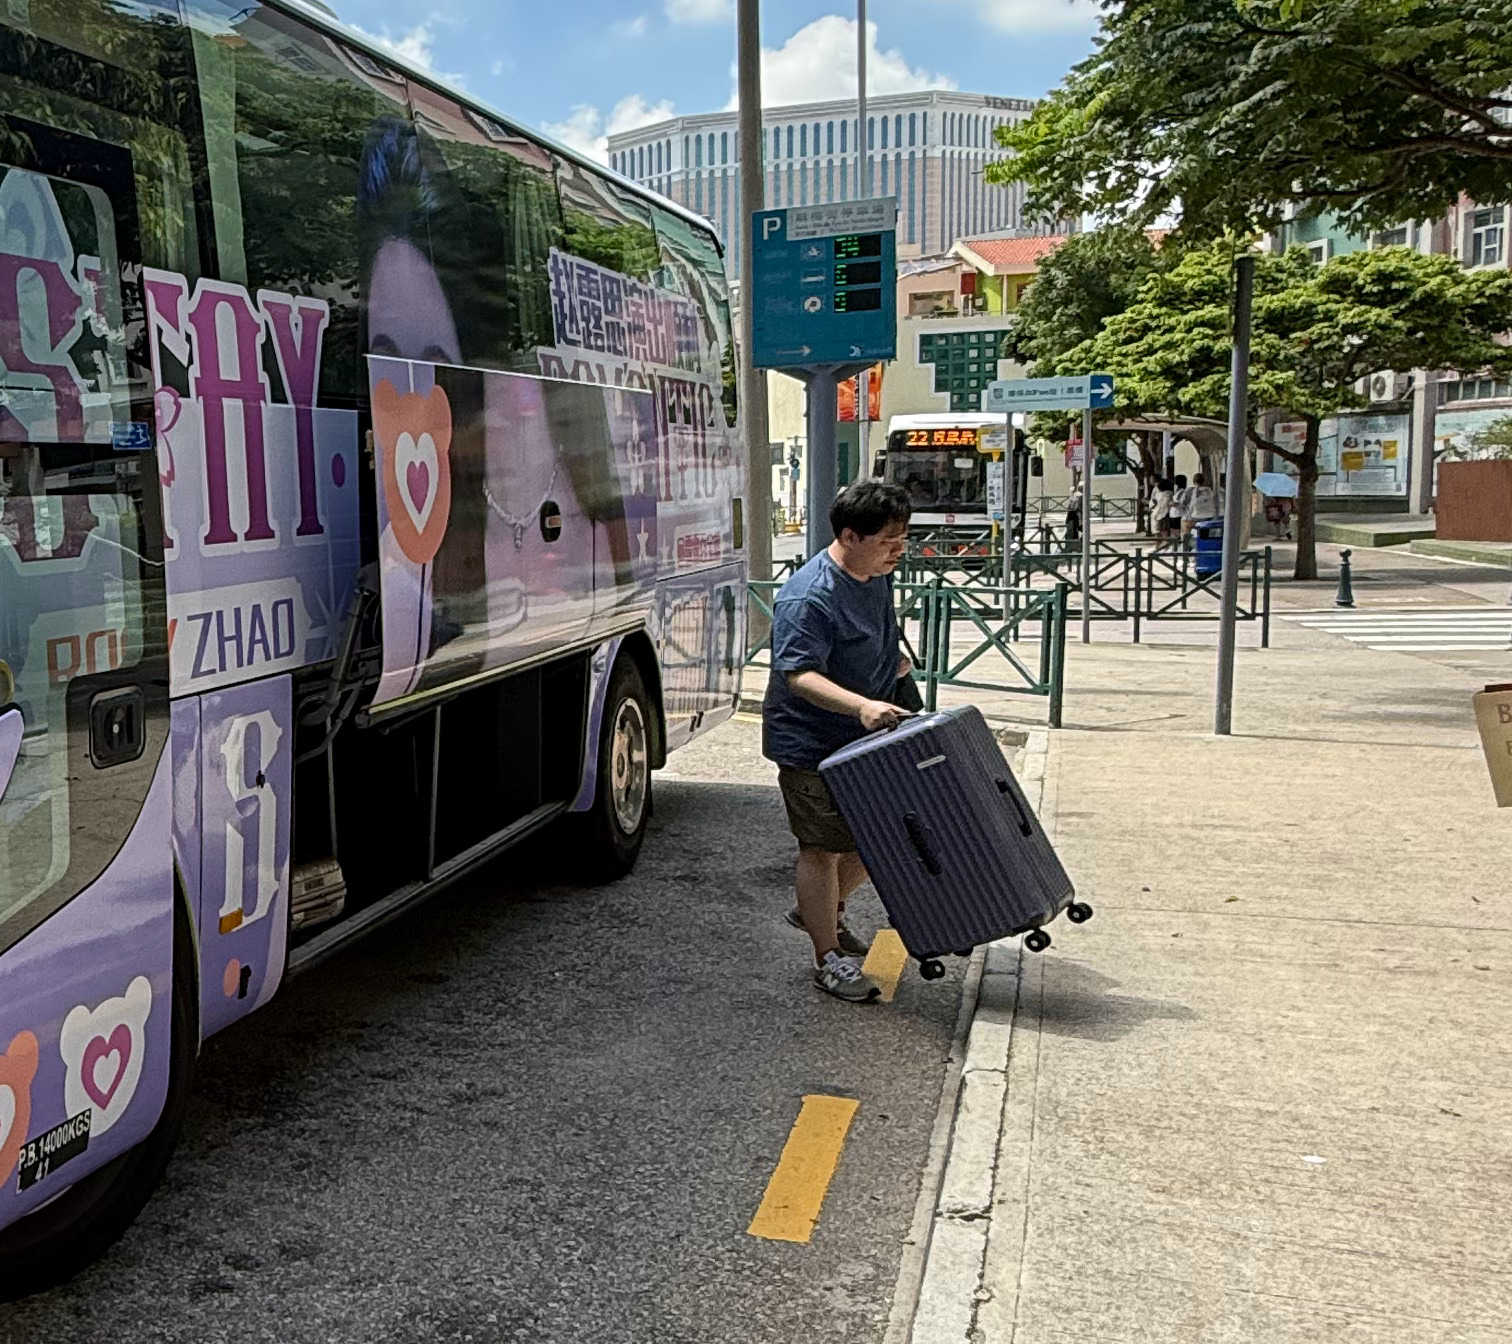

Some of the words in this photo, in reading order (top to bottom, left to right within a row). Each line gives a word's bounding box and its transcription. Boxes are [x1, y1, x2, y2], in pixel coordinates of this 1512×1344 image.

[984, 96, 1035, 112] VENETI
[763, 217, 781, 241] P
[188, 597, 295, 680] ZHAO
[34, 1156, 50, 1181] 41
